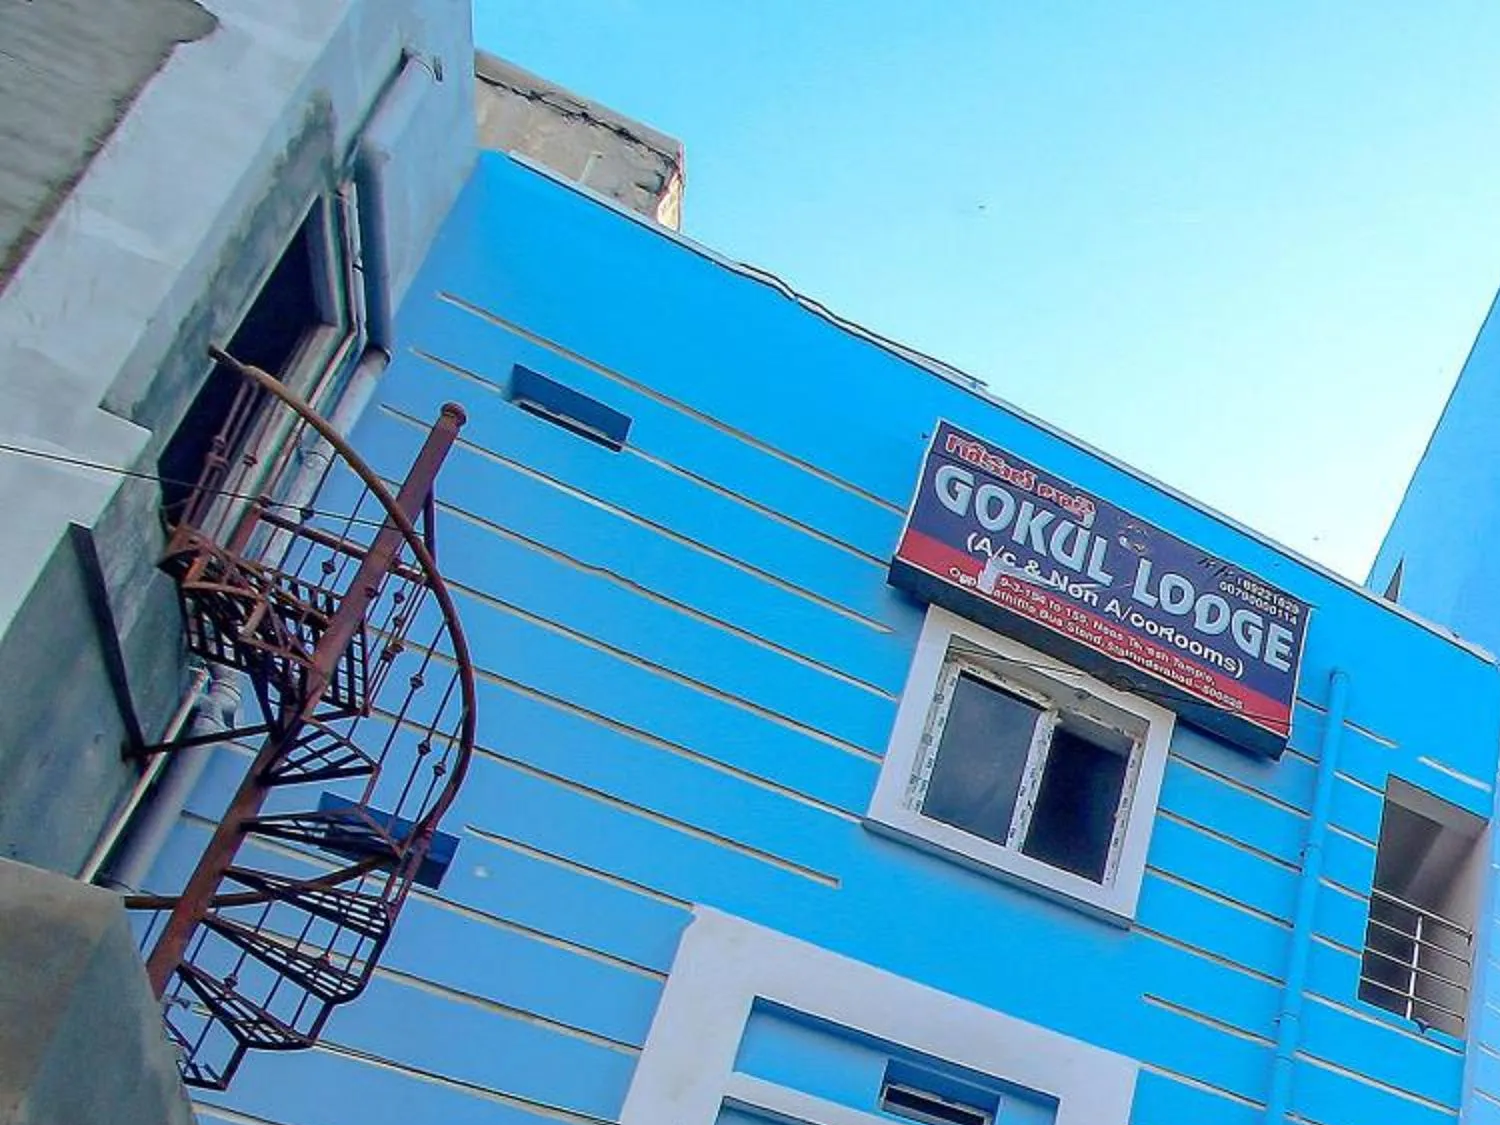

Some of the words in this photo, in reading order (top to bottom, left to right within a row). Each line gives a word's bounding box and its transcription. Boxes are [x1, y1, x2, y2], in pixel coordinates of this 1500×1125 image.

[935, 465, 1115, 587] GOKUL
[1132, 557, 1293, 672] LODGE
[1024, 560, 1041, 577] &
[1050, 570, 1100, 607] Non
